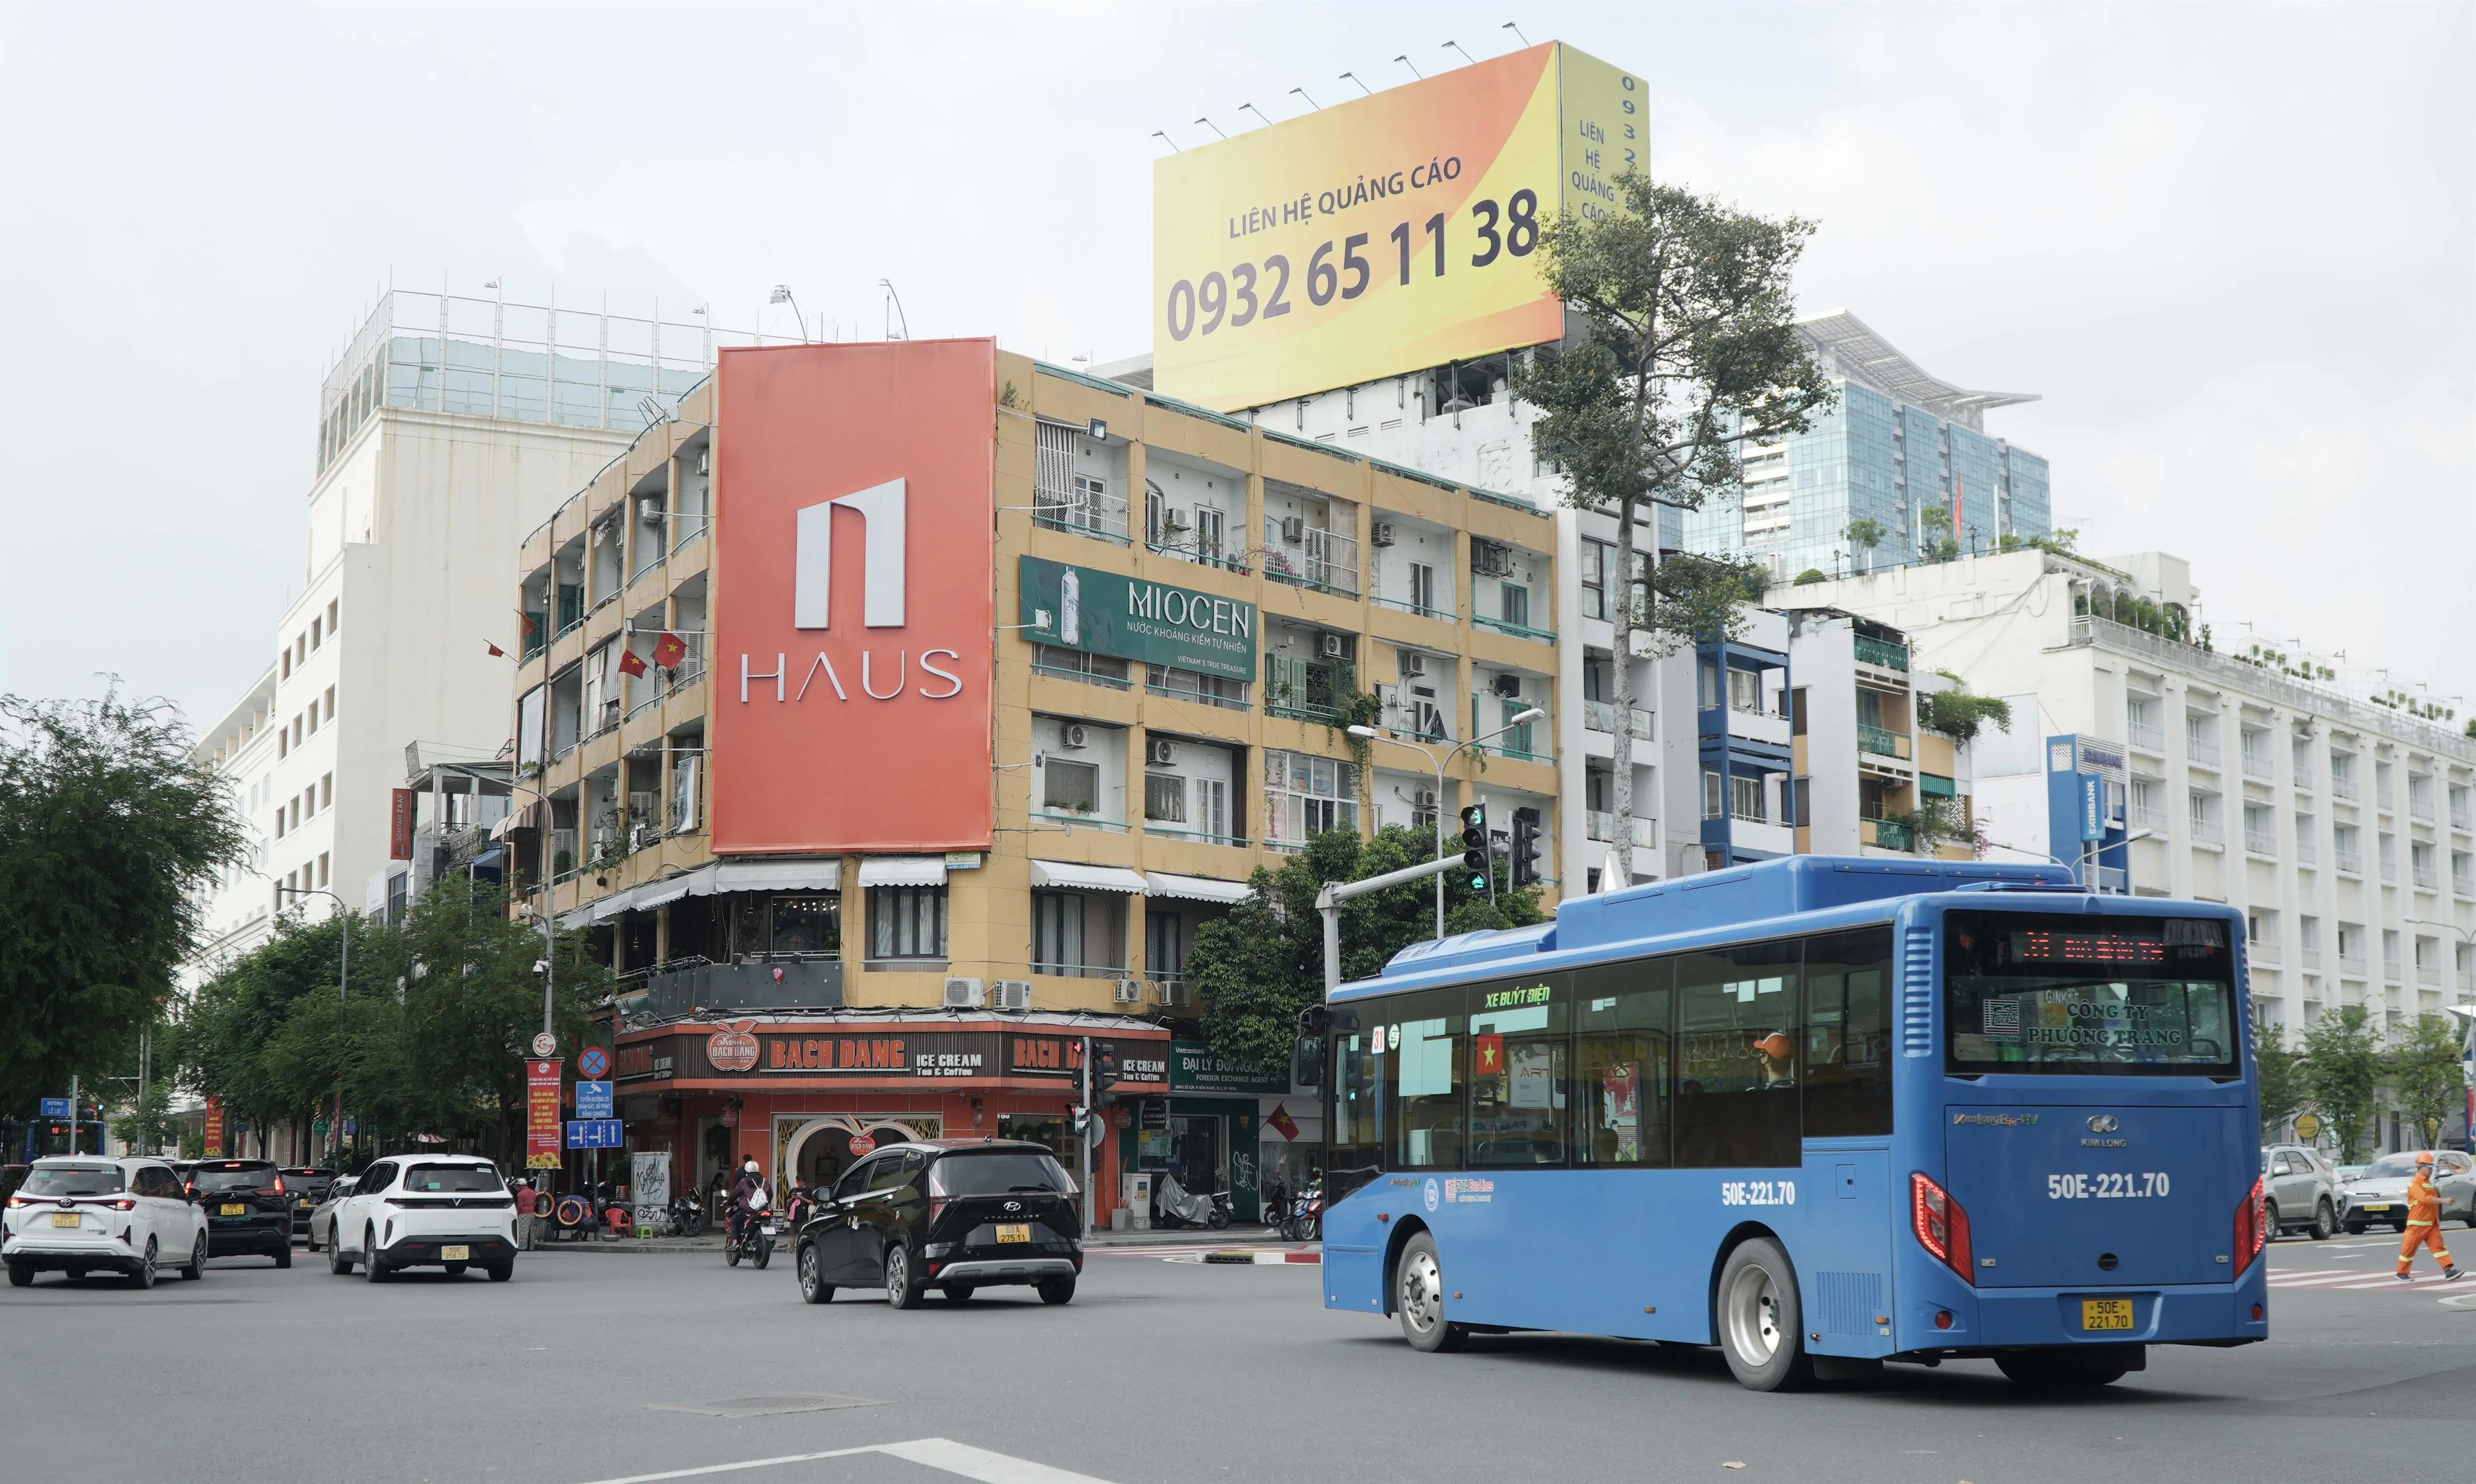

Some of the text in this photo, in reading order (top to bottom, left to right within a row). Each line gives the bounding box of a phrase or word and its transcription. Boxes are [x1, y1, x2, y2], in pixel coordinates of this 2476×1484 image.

[1580, 120, 1604, 144] LIÊN
[1586, 149, 1601, 173] HỆ
[1230, 156, 1461, 239] LIÊN HỆ QUẢNG CÁO
[1572, 171, 1614, 202] QUẢNG
[1167, 254, 1291, 342] 0932
[1307, 232, 1370, 306] 65
[1391, 211, 1445, 286] 11
[1472, 188, 1539, 268] 38
[1129, 582, 1249, 638] MIOCEN
[1127, 621, 1152, 635] NƯỚC
[1154, 625, 1190, 642] KHOÁNG
[1212, 637, 1223, 650] TỰ
[1224, 641, 1247, 654] NHIÊN
[741, 648, 963, 703] HAUS
[1207, 660, 1220, 669] TRUE
[1221, 663, 1247, 674] TREASURE
[2087, 780, 2096, 835] EXIMBANK
[1485, 983, 1551, 1008] XE BUÝT ĐIỆN
[2066, 999, 2149, 1021] CÔNG TY
[1374, 1030, 1383, 1050] 31
[2027, 1026, 2182, 1046] PHƯƠNG TRANG
[771, 1040, 904, 1068] BACH DANG
[916, 1054, 981, 1067] ICE CREAM
[1014, 1039, 1060, 1069] BACH
[1123, 1059, 1165, 1073] ICE CREAM
[1182, 1057, 1199, 1073] ĐẠI
[1202, 1056, 1213, 1071] LÝ
[916, 1068, 932, 1076] Tea
[943, 1068, 973, 1077] Coffee
[2081, 1138, 2126, 1147] KIM LONG
[1722, 1181, 1796, 1206] 50E-221.70
[2048, 1172, 2170, 1199] 50E-221.70
[2097, 1301, 2119, 1314] 50E
[2089, 1315, 2128, 1328] 221.70
